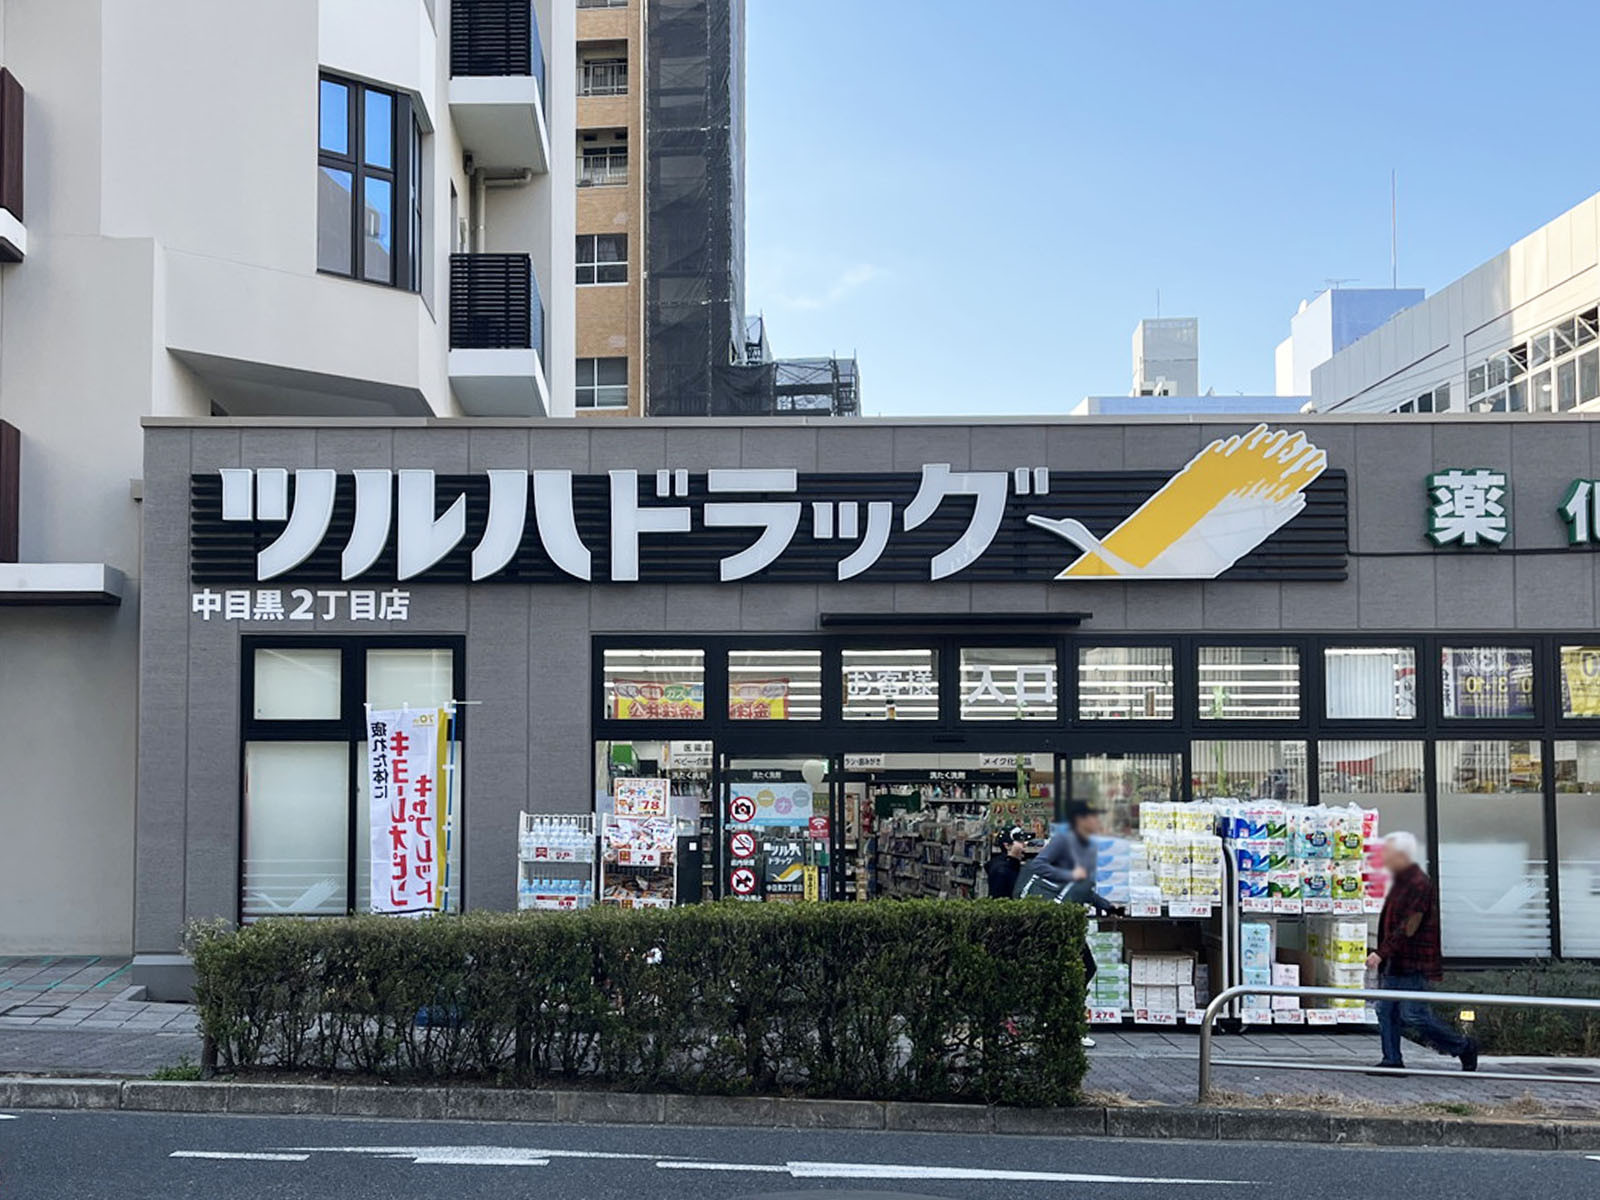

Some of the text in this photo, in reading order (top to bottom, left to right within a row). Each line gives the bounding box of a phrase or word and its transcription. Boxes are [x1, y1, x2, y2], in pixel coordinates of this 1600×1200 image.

[219, 462, 1049, 582] ツルハドラッグ
[1432, 470, 1508, 544] 薬
[192, 589, 411, 621] 中目黒2丁目店
[848, 670, 933, 696] お客様
[967, 665, 1054, 703] 入口
[983, 757, 1032, 766] メイク化品
